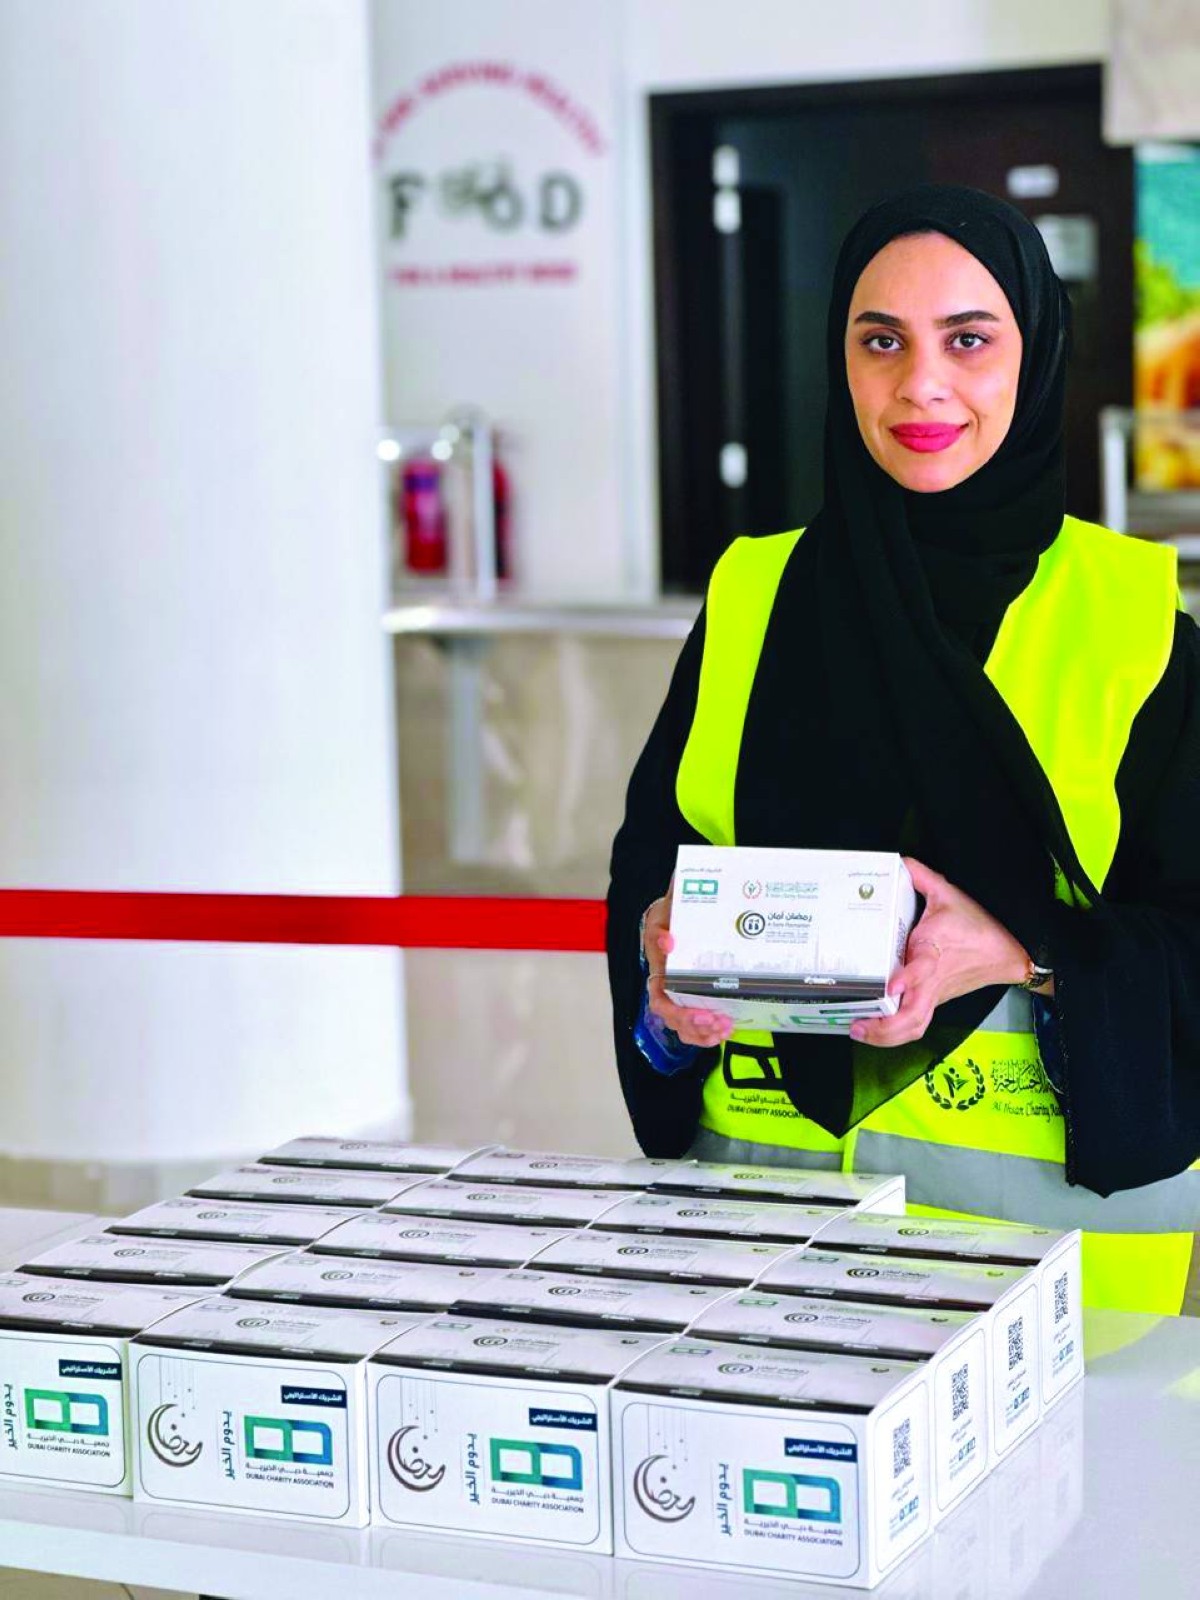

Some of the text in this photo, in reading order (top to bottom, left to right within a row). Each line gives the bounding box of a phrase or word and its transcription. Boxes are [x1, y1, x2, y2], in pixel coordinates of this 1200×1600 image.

[727, 1103, 744, 1113] DUBAI
[745, 1107, 769, 1115] CHARITY
[3, 1383, 18, 1450] يدوم الخير
[27, 1433, 57, 1442] الخيرية
[221, 1410, 236, 1480] يدوم الخير
[27, 1442, 111, 1458] DUBAI CHARITY ASSOCIATION
[245, 1462, 277, 1472] الخيرية
[465, 1433, 480, 1505] يدوم الخير
[245, 1472, 335, 1489] DUBAI CHARITY ASSOCIATION
[491, 1486, 525, 1496] الخيرية
[491, 1497, 584, 1513] DUBAI CHARITY ASSOCIATION
[716, 1463, 733, 1537] يدوم الخير
[744, 1518, 780, 1528] الخيرية
[744, 1529, 843, 1547] DUBAI CHARITY ASSOCIATION
